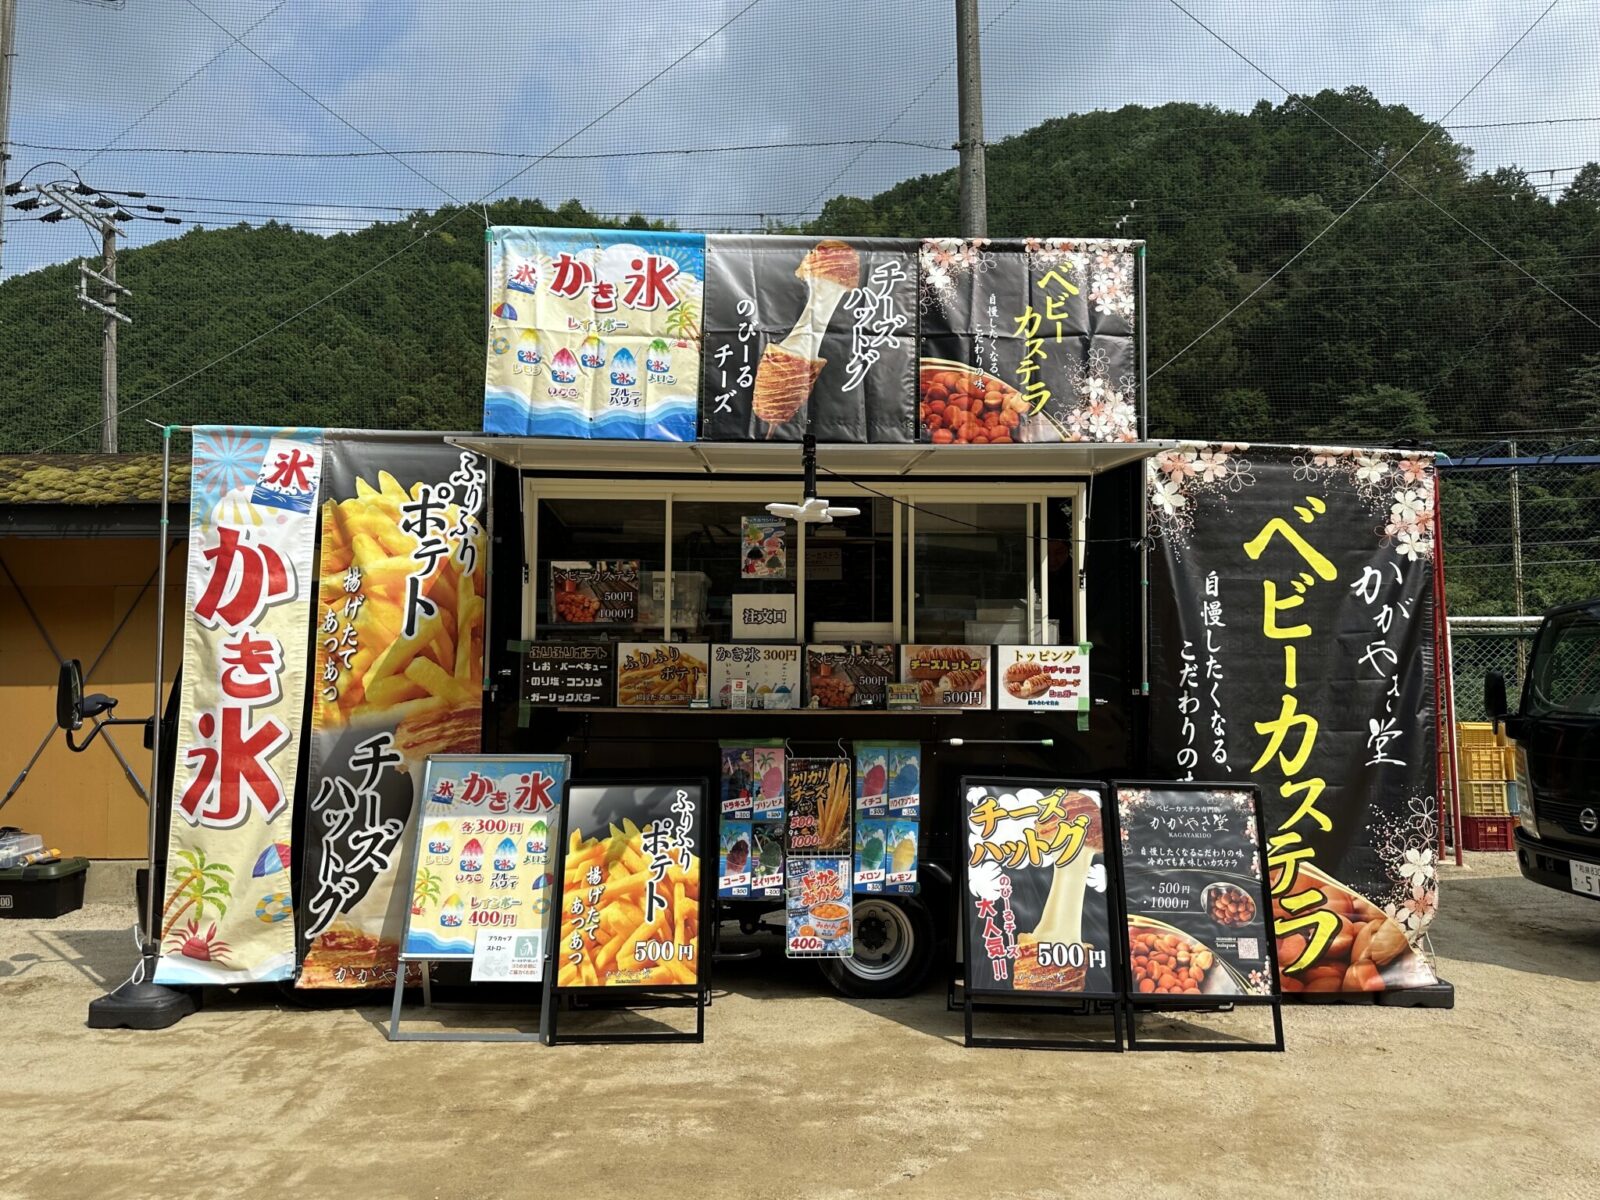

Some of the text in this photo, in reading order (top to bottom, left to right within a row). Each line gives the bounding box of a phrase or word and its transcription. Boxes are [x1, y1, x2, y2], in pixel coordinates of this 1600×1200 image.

[513, 264, 536, 283] 氷
[550, 253, 680, 311] かき氷
[871, 261, 907, 348] チーズ
[1037, 261, 1079, 343] ベビー
[568, 317, 629, 332] レインボー
[737, 300, 758, 387] のびーる
[842, 287, 880, 392] ハットグ
[1013, 306, 1051, 416] カステラ
[714, 344, 737, 413] チーズ
[610, 397, 641, 406] ハワイ
[611, 388, 641, 397] ブルー
[267, 449, 314, 490] 氷
[452, 453, 485, 576] ふりふり
[402, 485, 453, 638] ポテト
[555, 571, 637, 581] ベビーカステラ
[604, 592, 633, 602] 500円
[339, 567, 364, 669] 揚げたて
[600, 608, 634, 619] 1000円
[743, 608, 787, 624] 注文口
[322, 608, 339, 701] あつあつ
[624, 645, 680, 670] ふりふり
[716, 647, 797, 662] かき氷 300円
[1015, 650, 1075, 662] トッピング
[180, 525, 289, 822] かき氷
[911, 659, 981, 670] チーズハットグ
[1202, 571, 1231, 772] 自慢したくなる、
[859, 676, 888, 685] 500円
[943, 690, 982, 704] 500円
[1177, 641, 1200, 782] こだわりの
[1243, 496, 1341, 975] ベビーカステラ
[789, 769, 827, 787] カリカリ
[437, 781, 454, 796] 氷
[460, 771, 554, 812] かき氷
[790, 783, 829, 803] チーズ
[347, 732, 403, 872] チーズ
[724, 797, 751, 810] ドラキュラ
[755, 799, 783, 809] プリンセス
[862, 797, 882, 806] イチゴ
[969, 787, 1067, 839] チーズ
[461, 819, 523, 834] 各300円
[672, 790, 695, 874] ふりふり
[1150, 814, 1229, 832] かがやき堂
[970, 815, 1089, 867] ハットグ
[306, 776, 359, 939] ハットグ
[1141, 847, 1244, 857] 自慢したくなるこだわりの味
[642, 819, 673, 924] ポテト
[1147, 858, 1238, 867] 冷めても美味しいカステラ
[455, 874, 484, 883] いちご
[490, 880, 518, 889] ハワイ
[491, 873, 518, 881] ブルー
[724, 875, 746, 885] コーラ
[860, 872, 881, 881] メロン
[890, 874, 912, 883] レモン
[471, 897, 522, 909] レインボー
[587, 866, 604, 941] 揚げたて
[801, 886, 843, 907] みかん
[469, 911, 517, 926] 400円
[1000, 876, 1019, 959] のびーるチーズ
[568, 897, 585, 965] あつあつ
[635, 940, 694, 961] 500円
[791, 938, 823, 949] 400円
[1038, 943, 1106, 968] 500円
